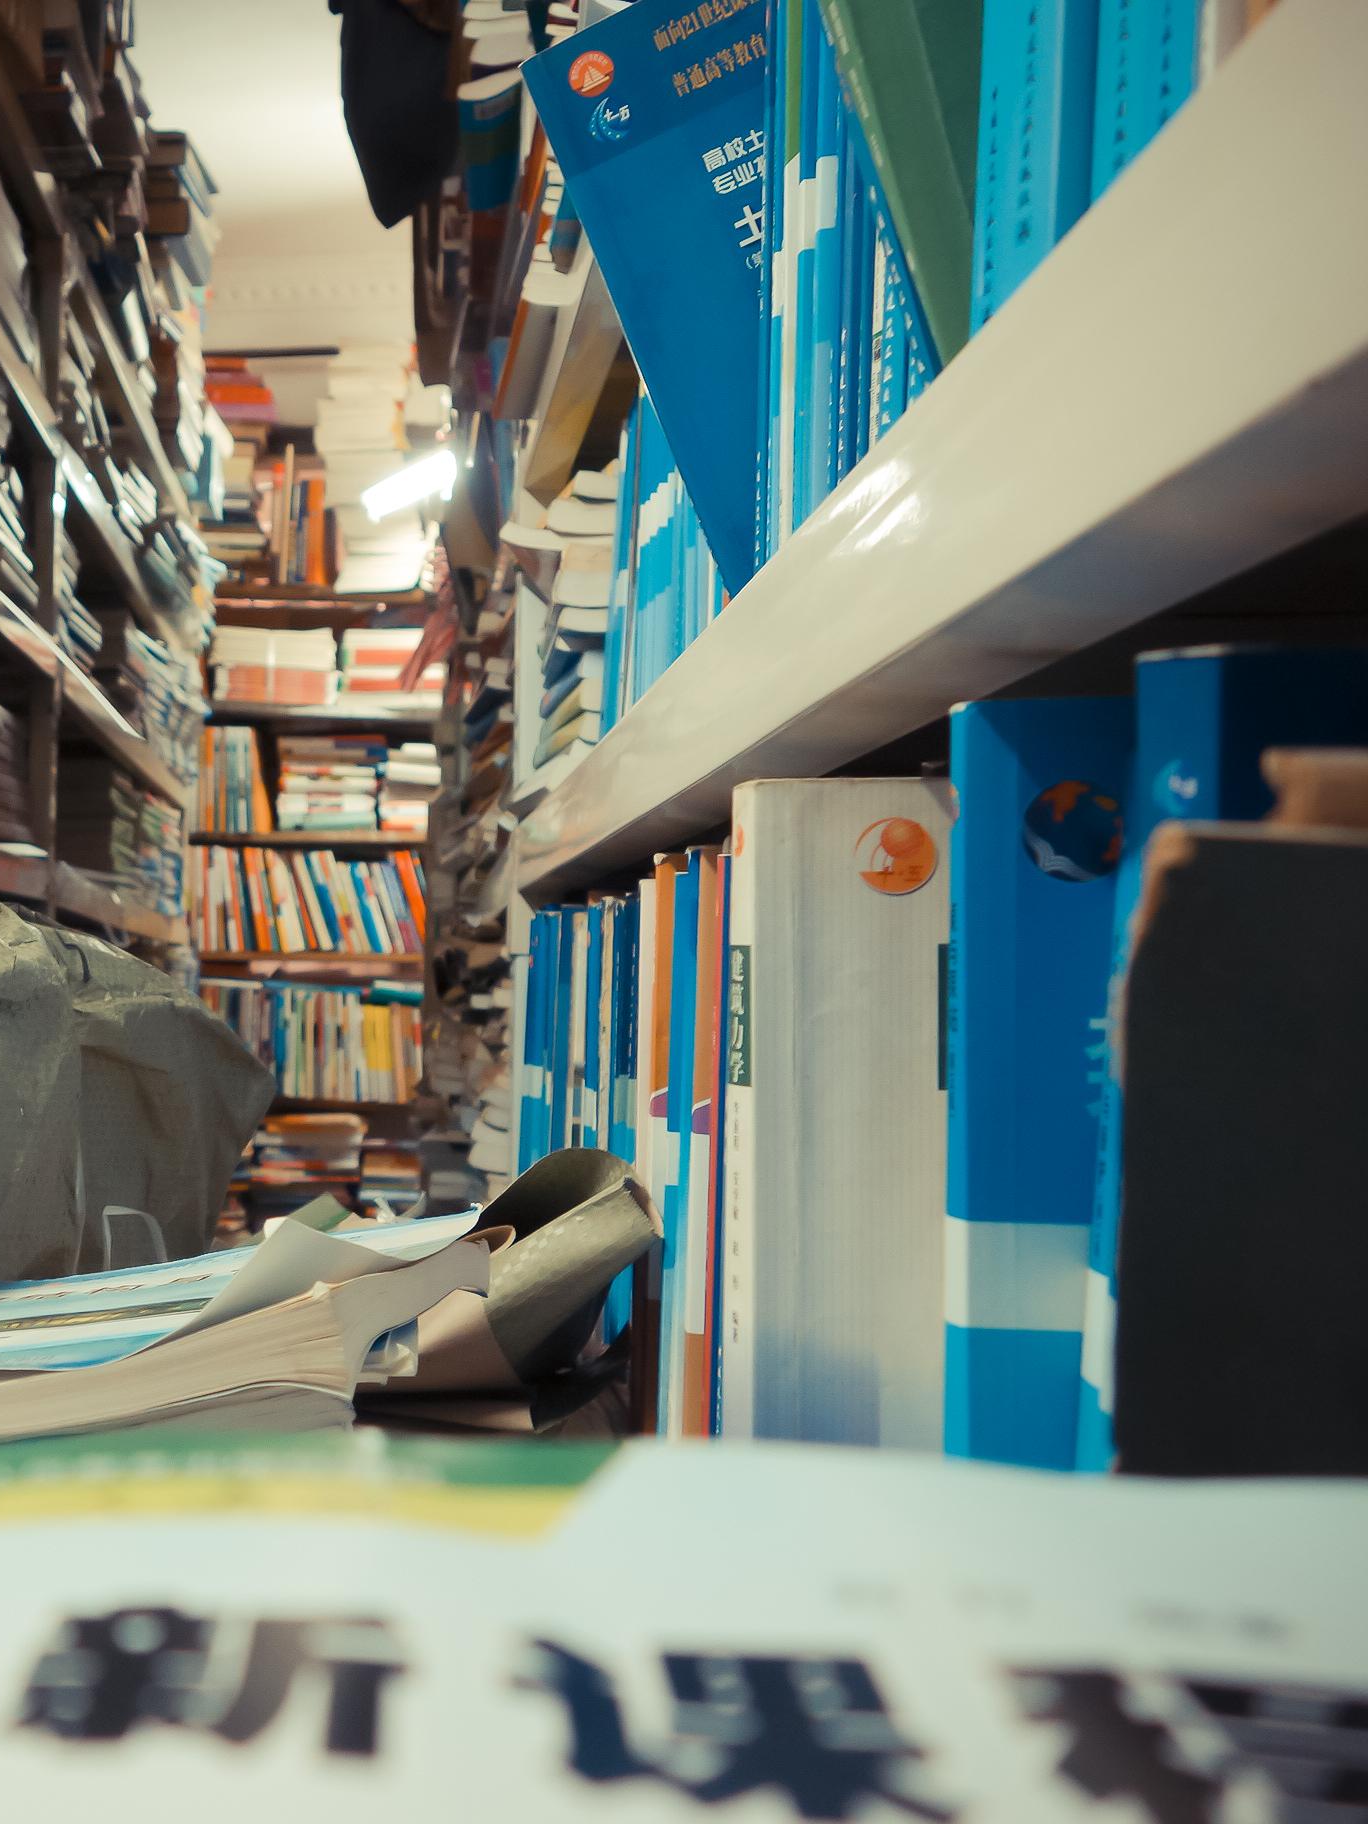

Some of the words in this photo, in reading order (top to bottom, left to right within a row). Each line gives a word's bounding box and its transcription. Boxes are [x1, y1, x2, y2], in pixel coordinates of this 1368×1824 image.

[673, 33, 767, 97] 普通高等教育
